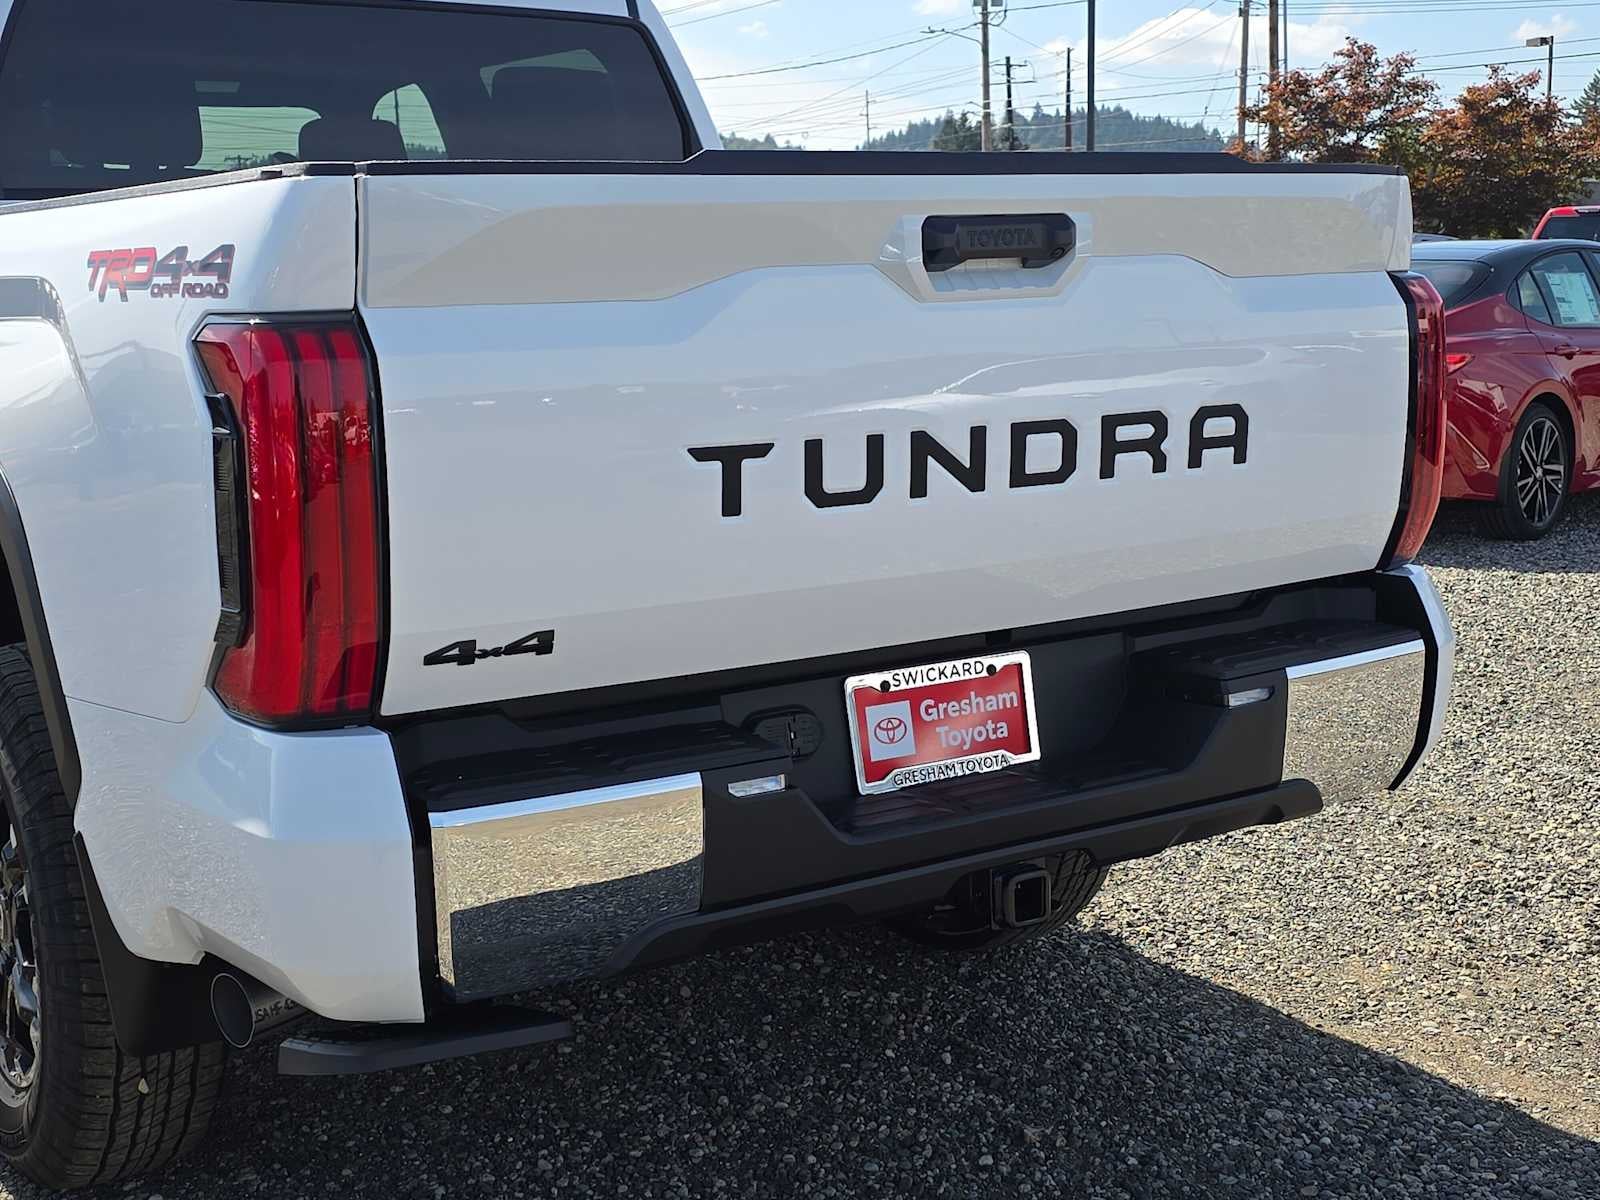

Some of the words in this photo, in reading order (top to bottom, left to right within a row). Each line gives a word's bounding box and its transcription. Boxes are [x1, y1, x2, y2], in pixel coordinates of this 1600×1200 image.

[966, 226, 1038, 248] TOYOTA
[87, 246, 158, 302] TRD
[150, 282, 180, 298] OFF
[181, 282, 229, 298] ROAD
[687, 403, 1250, 518] TUNDRA
[423, 629, 555, 666] 4x4
[892, 660, 985, 688] SWICKARD
[919, 690, 1018, 723] Gresham
[935, 719, 1009, 750] Toyota
[893, 764, 957, 786] GRESHAM
[959, 754, 1010, 773] TOYOTA
